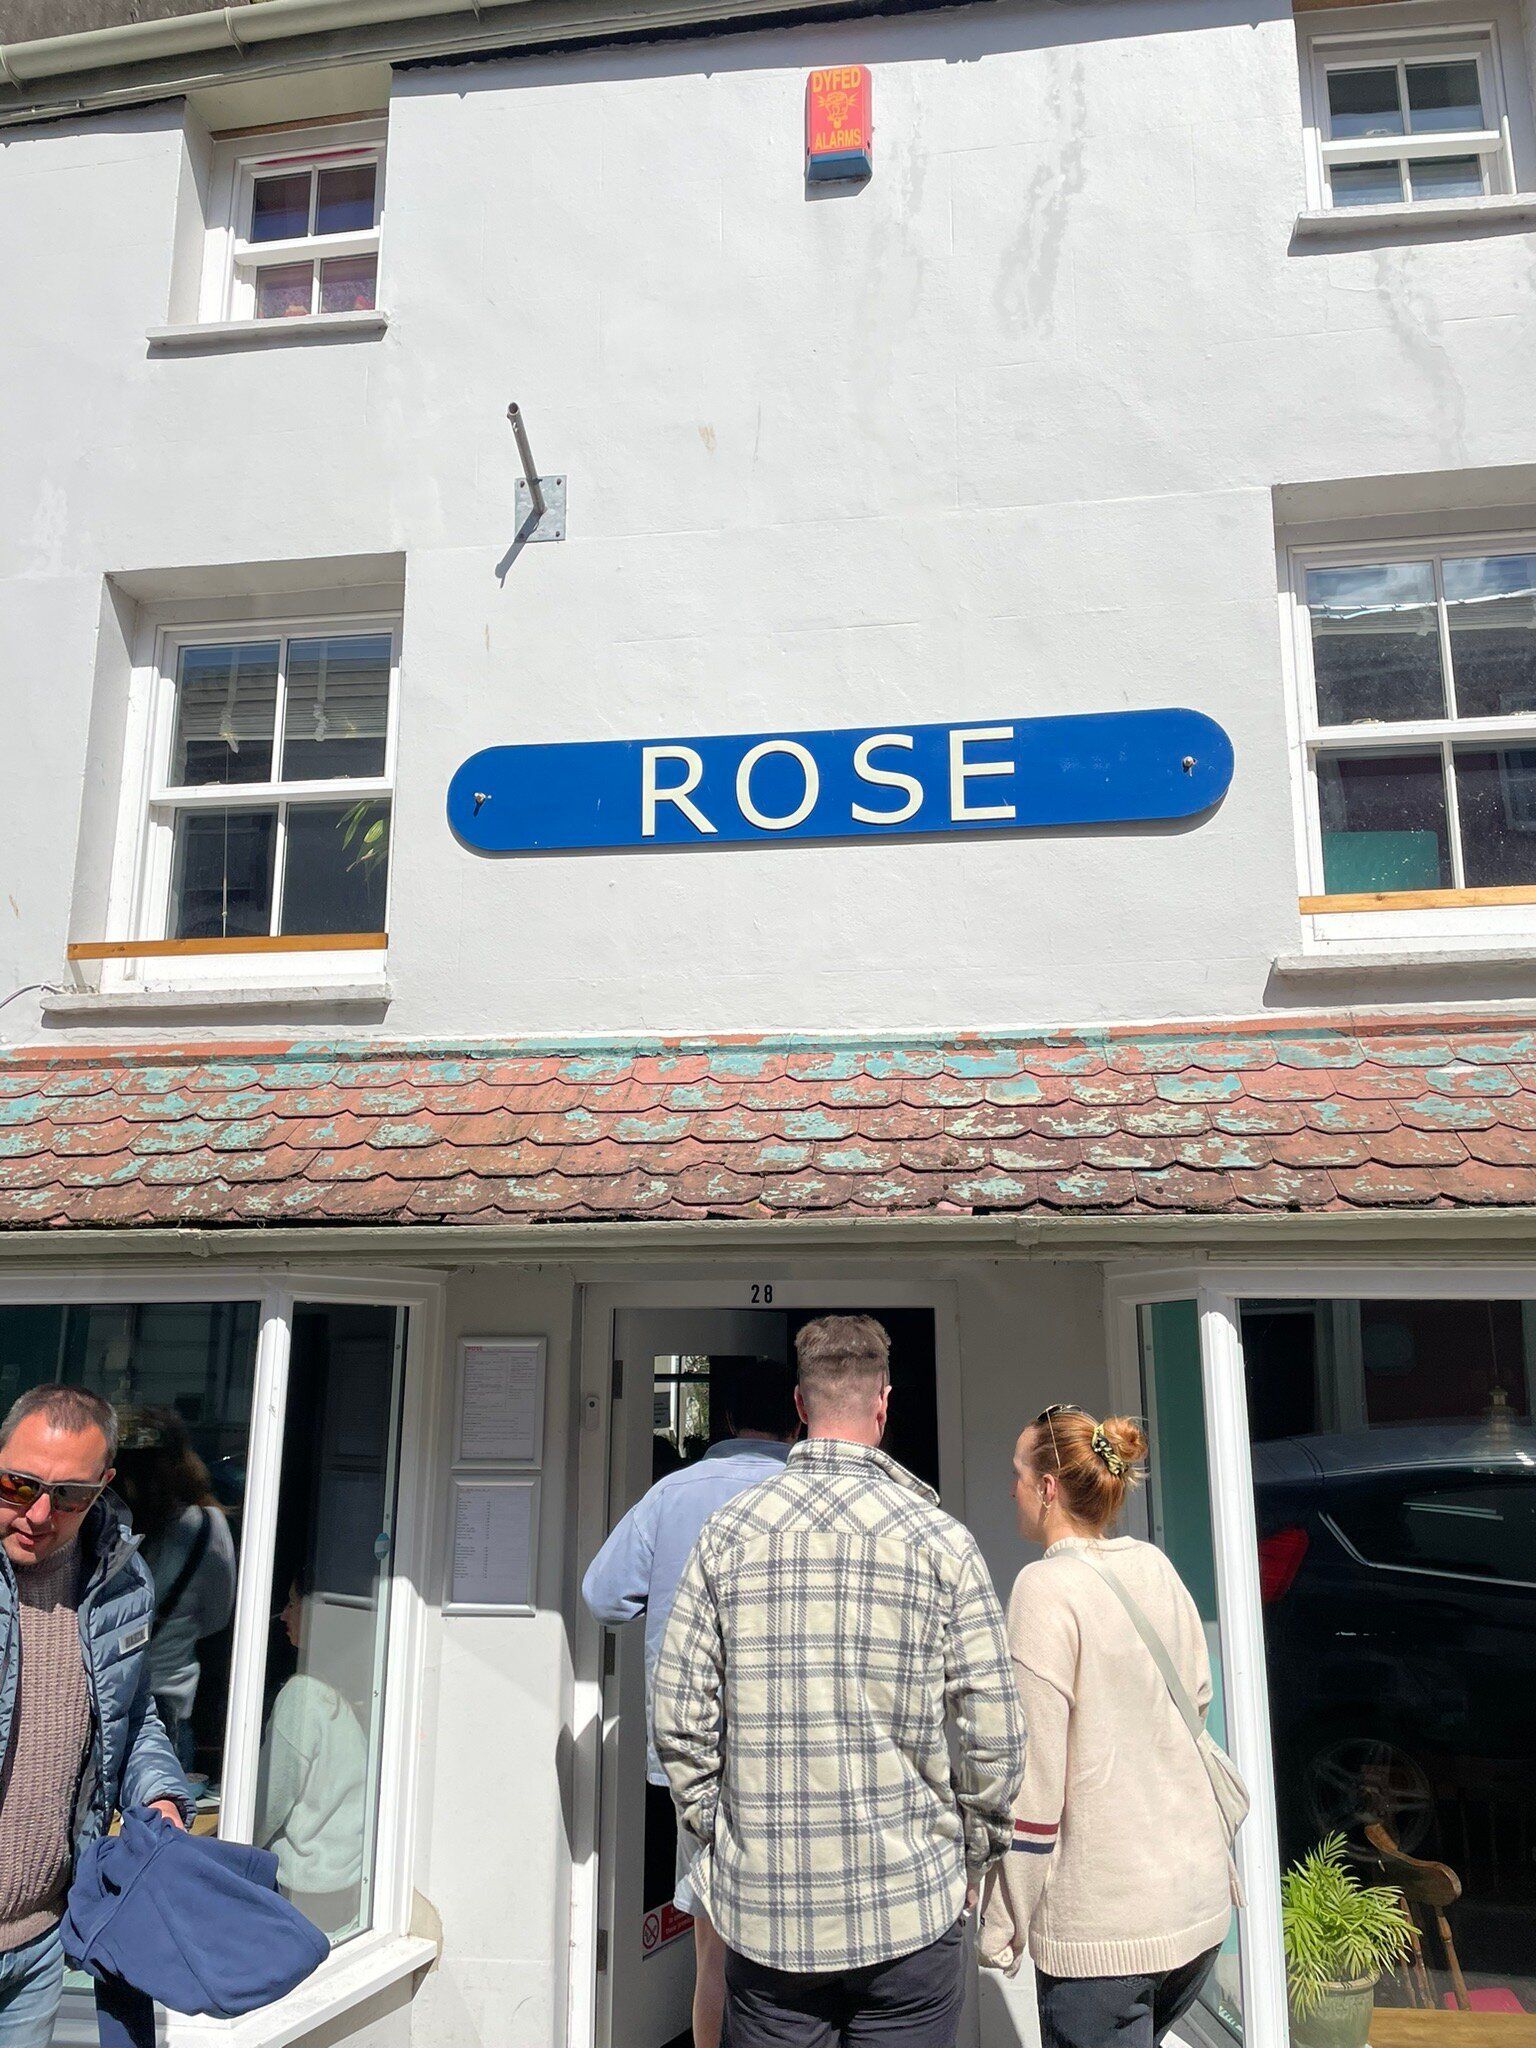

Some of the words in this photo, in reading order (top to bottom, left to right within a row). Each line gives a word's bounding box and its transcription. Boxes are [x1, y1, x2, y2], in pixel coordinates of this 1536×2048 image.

[812, 66, 861, 93] DYFED
[815, 128, 861, 151] ALARMS
[642, 727, 1016, 836] ROSE
[751, 1284, 773, 1304] 28
